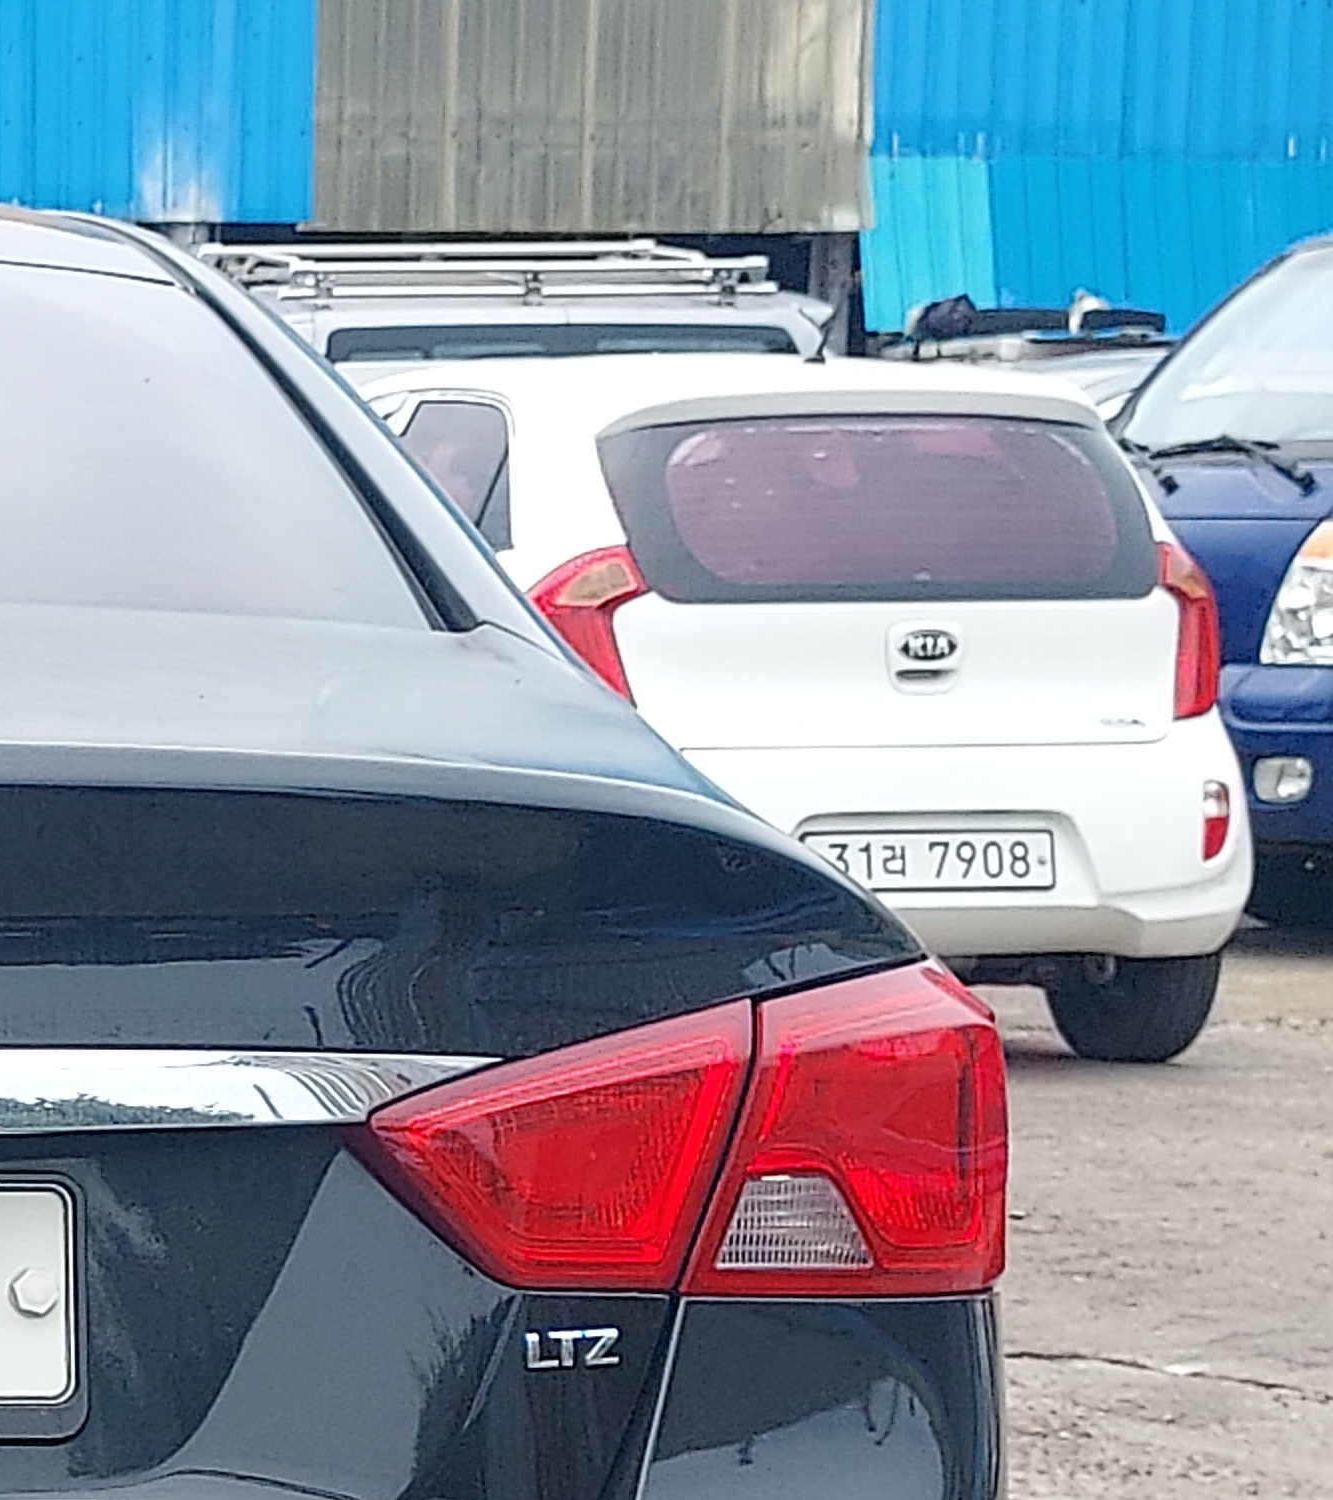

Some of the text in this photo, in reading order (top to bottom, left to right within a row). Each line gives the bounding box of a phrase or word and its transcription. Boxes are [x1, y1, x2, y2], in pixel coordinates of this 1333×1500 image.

[905, 633, 952, 658] KIA
[929, 841, 1031, 879] 7908
[525, 1327, 620, 1369] LTZ
